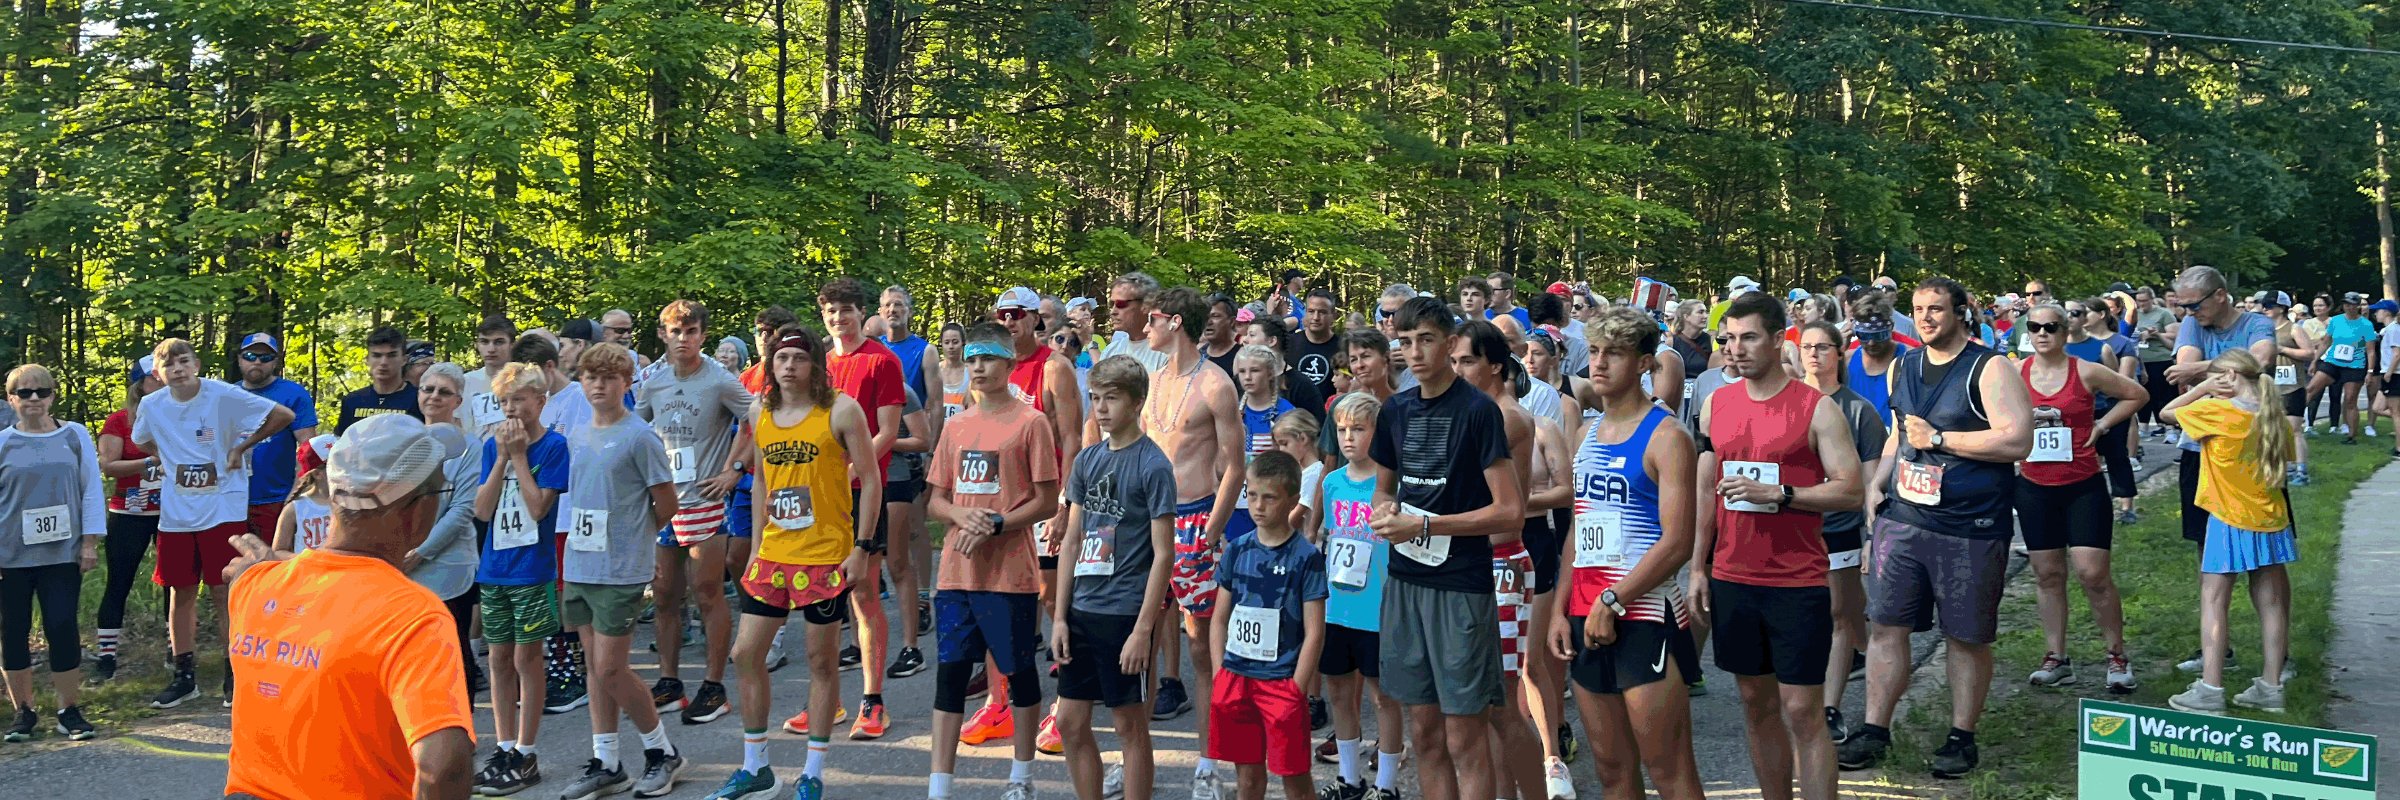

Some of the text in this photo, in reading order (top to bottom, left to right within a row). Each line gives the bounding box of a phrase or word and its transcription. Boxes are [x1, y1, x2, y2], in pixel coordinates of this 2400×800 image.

[2277, 368, 2289, 378] 50
[763, 440, 819, 456] MIDLAND
[2038, 431, 2059, 449] 65
[183, 471, 209, 487] 739
[962, 460, 988, 481] 769
[1903, 470, 1932, 492] 745
[1574, 472, 1628, 504] USA
[773, 496, 801, 517] 795
[35, 515, 58, 534] 387
[501, 511, 522, 533] 44
[1080, 537, 1102, 561] 782
[1582, 526, 1603, 551] 390
[1333, 543, 1356, 568] 73
[1236, 619, 1261, 644] 389
[232, 633, 320, 670] 25K RUN
[2139, 716, 2309, 756] Warrior's Run
[2150, 741, 2168, 755] 5K
[2170, 743, 2235, 764] Run/Walk
[2246, 755, 2270, 768] 10K
[2272, 756, 2298, 773] Run
